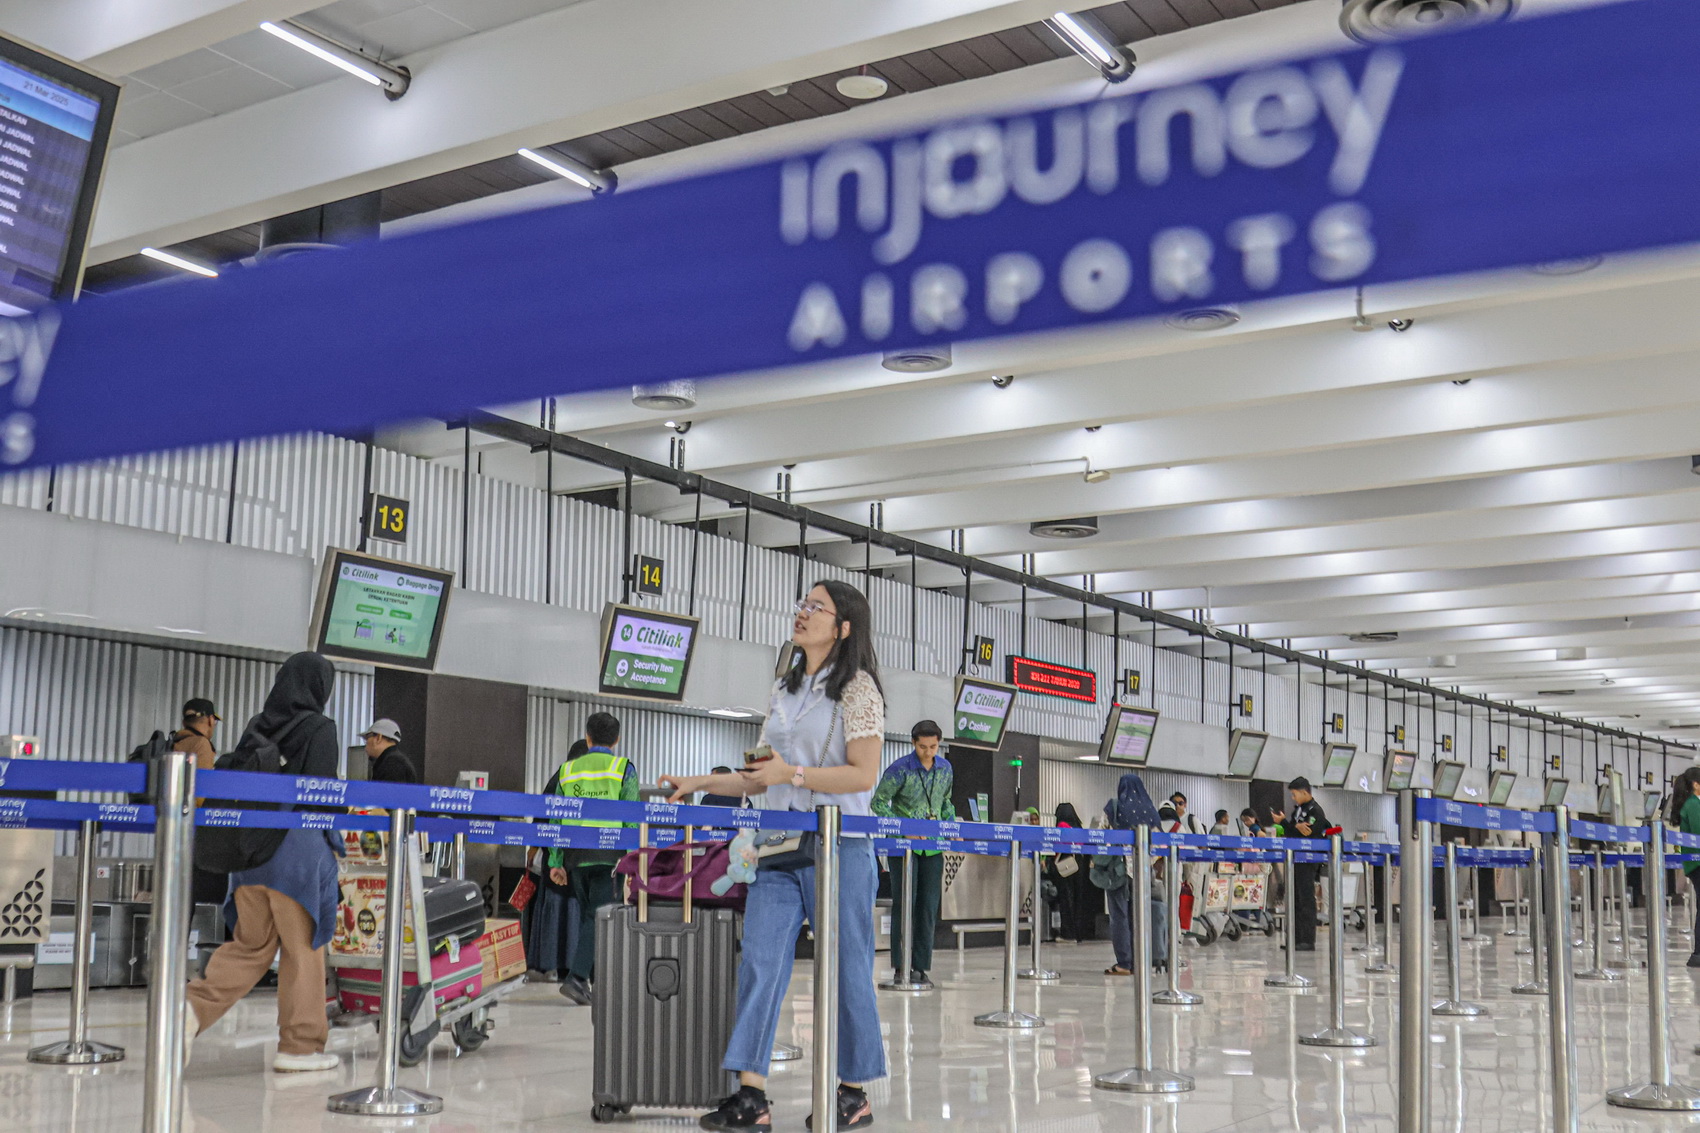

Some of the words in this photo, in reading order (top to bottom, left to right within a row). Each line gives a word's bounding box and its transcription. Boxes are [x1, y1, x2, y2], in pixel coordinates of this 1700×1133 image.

[24, 81, 33, 91] 21
[34, 83, 49, 97] Mar
[52, 91, 69, 107] 2025
[6, 127, 35, 144] JADWAL
[2, 141, 32, 158] JADWAL
[780, 44, 1404, 264] injourney
[788, 202, 1375, 350] AIRPORTS
[378, 505, 404, 533] 13
[352, 568, 379, 581] Citilink
[428, 583, 440, 592] Drop
[642, 564, 660, 588] 14
[636, 626, 684, 649] Citilink
[981, 643, 992, 660] 16
[634, 658, 660, 673] Security
[630, 672, 667, 686] Acceptance
[1130, 676, 1140, 690] 17
[974, 693, 1005, 709] Citilink
[969, 720, 991, 732] Cashier
[296, 778, 348, 795] injourney
[580, 789, 608, 798] Gapura
[296, 794, 345, 804] AIRPORTS
[430, 786, 475, 803] injourney
[99, 804, 140, 817] injourney
[430, 802, 472, 812] AIRPORTS
[545, 796, 584, 811] injourney
[205, 809, 242, 820] injourney
[546, 810, 582, 818] AIRPORTS
[644, 804, 678, 818] injourney
[732, 809, 762, 822] injourney
[301, 814, 335, 824] injourney
[469, 820, 495, 830] injourney
[646, 816, 677, 824] AIRPORTS
[537, 824, 561, 834] injourney
